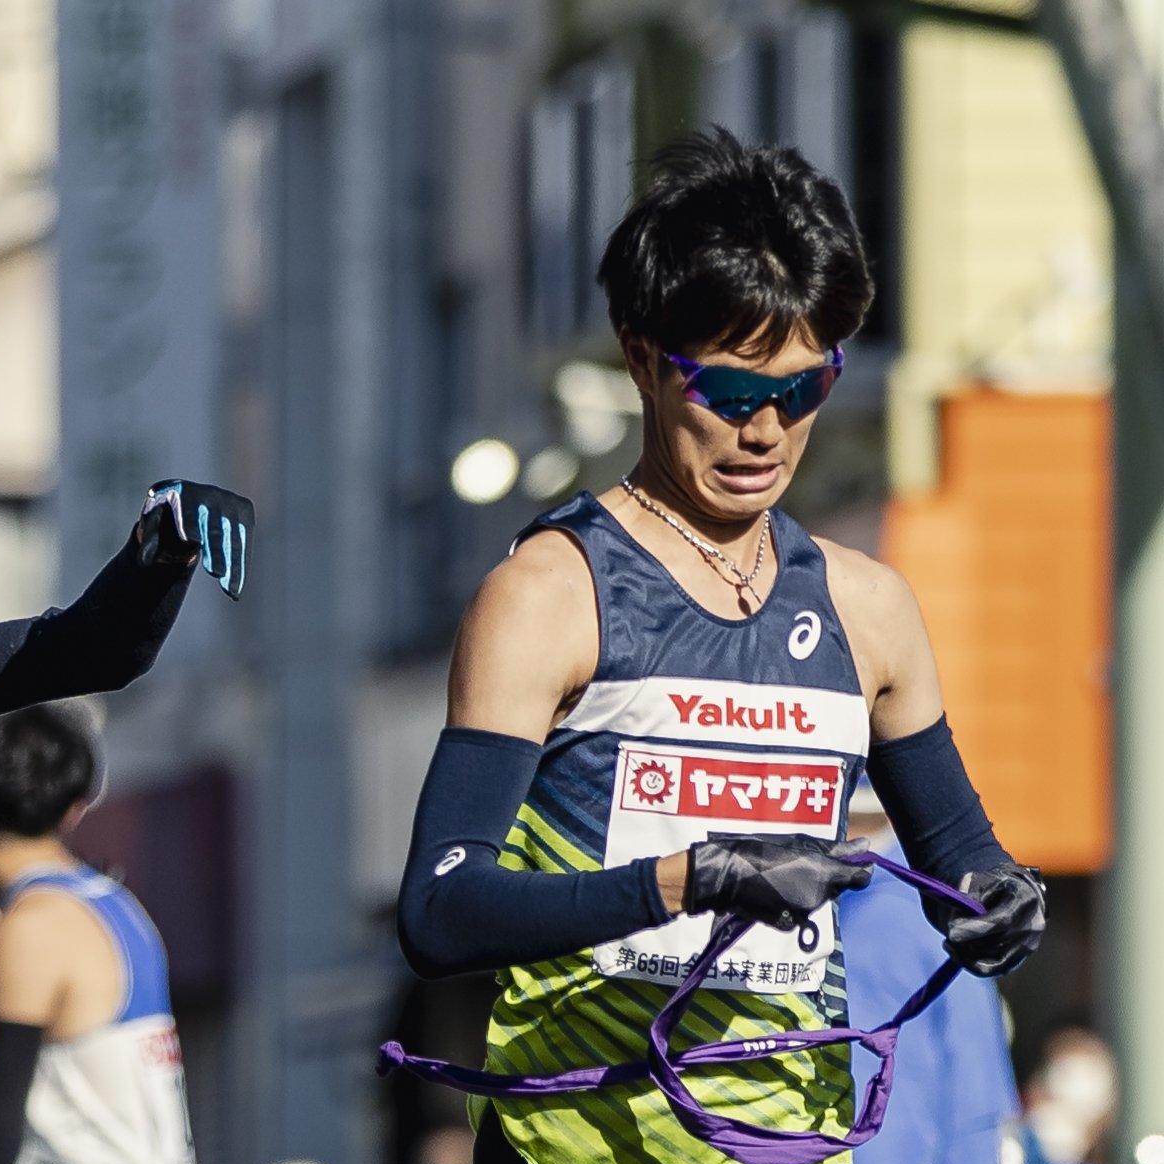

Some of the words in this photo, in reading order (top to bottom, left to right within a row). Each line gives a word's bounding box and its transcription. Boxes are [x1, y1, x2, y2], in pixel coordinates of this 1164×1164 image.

[668, 693, 817, 735] Yakult
[689, 768, 837, 813] ヤマザキ
